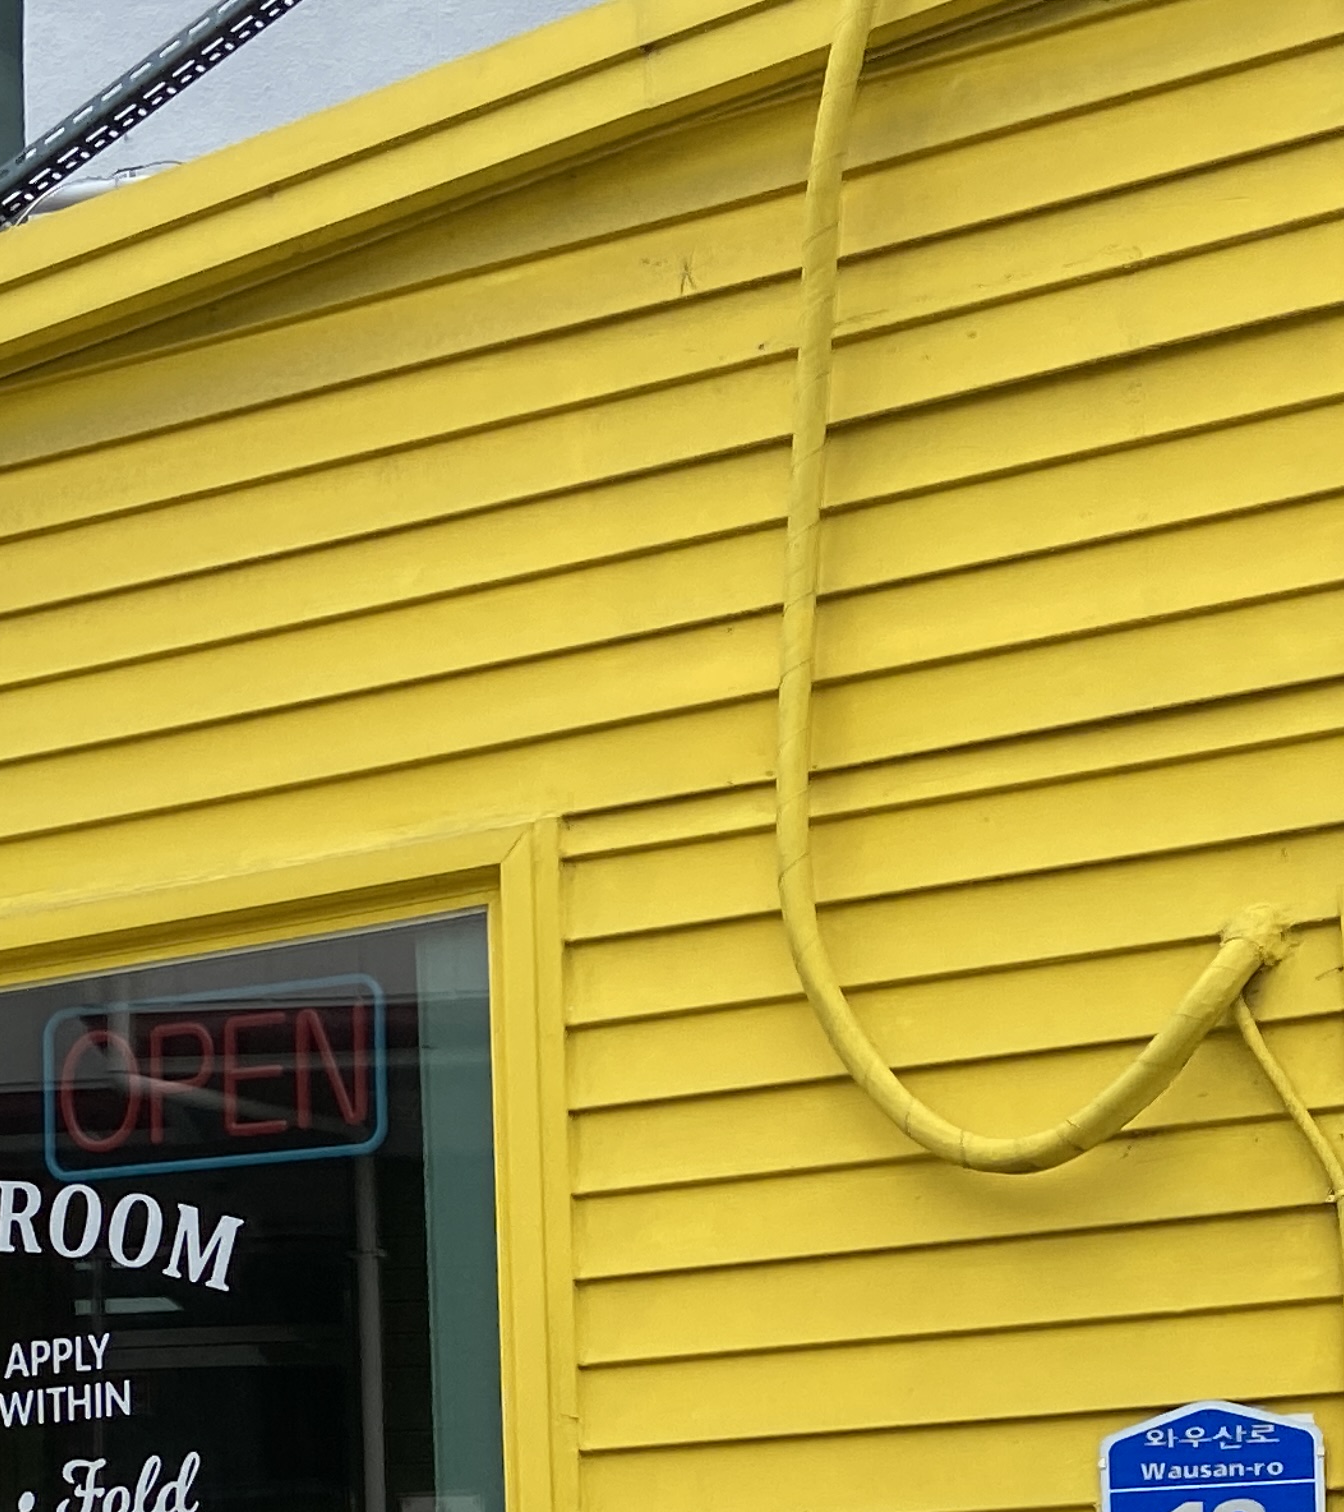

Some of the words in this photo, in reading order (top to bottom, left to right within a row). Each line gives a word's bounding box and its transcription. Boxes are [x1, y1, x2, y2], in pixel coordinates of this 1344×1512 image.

[61, 1003, 371, 1153] OPEN
[5, 1332, 111, 1379] APPLY
[1144, 1424, 1280, 1450] 와우산로
[1141, 1461, 1284, 1481] Wausan-ro
